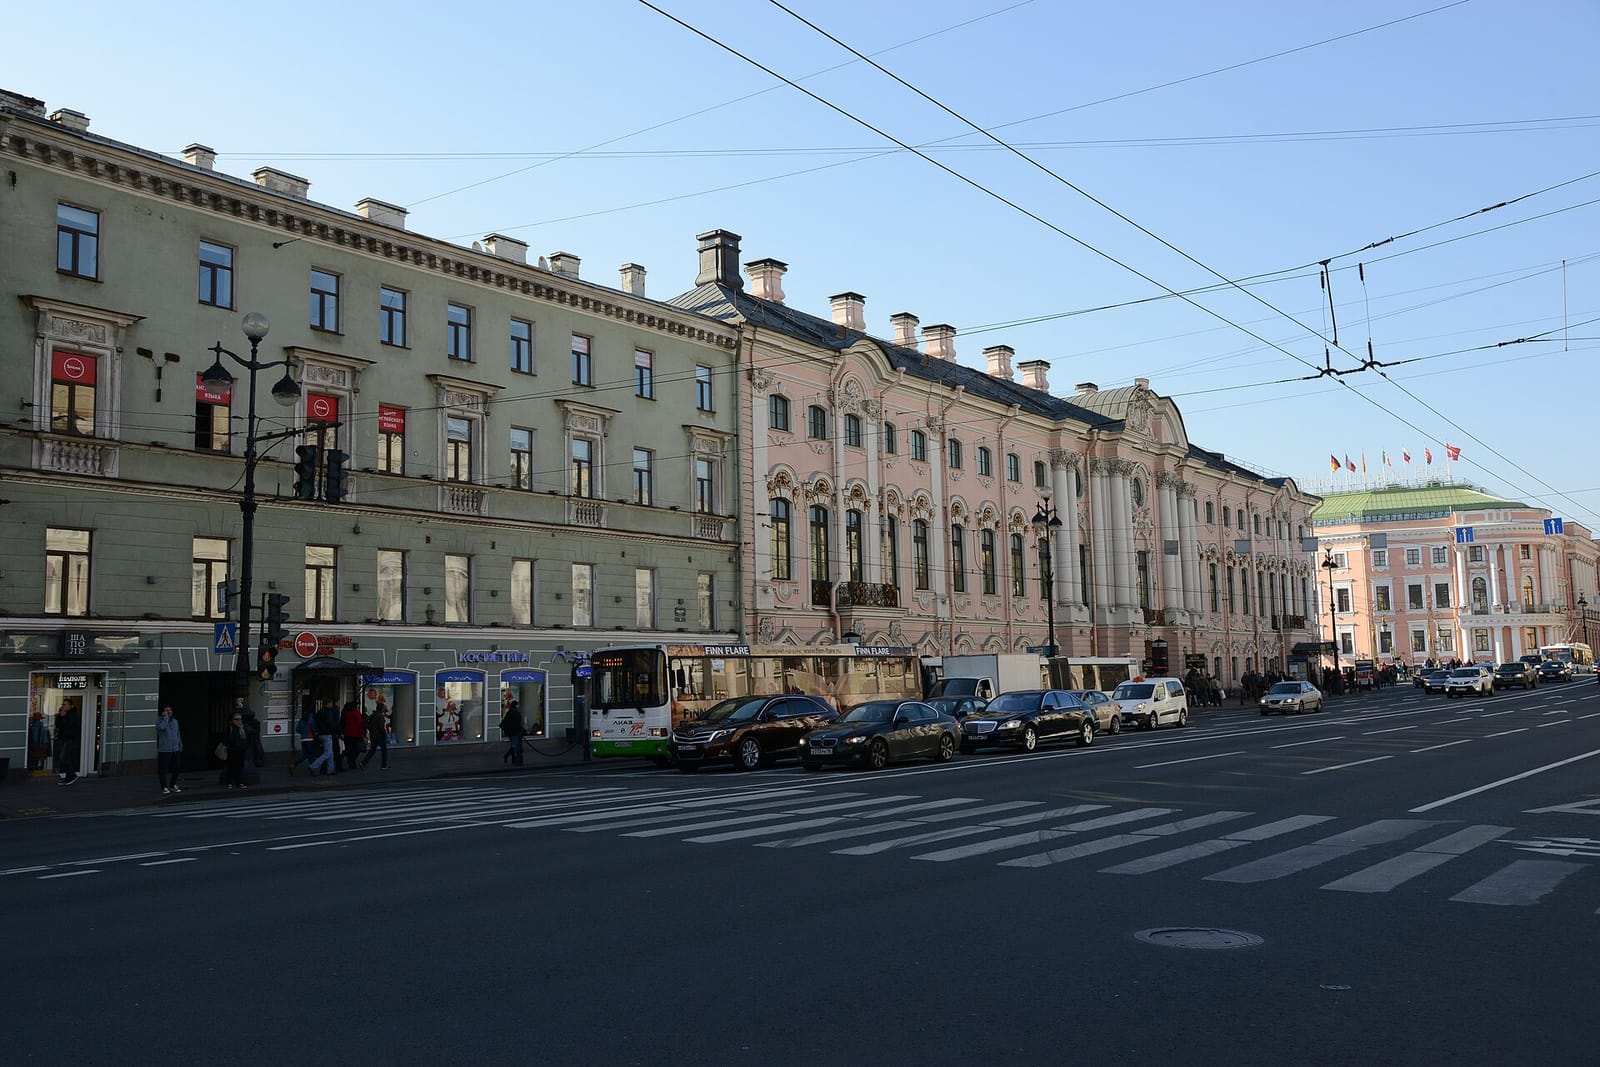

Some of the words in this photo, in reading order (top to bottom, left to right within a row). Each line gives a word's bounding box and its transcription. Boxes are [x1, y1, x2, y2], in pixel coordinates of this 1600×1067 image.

[70, 633, 86, 641] ША
[705, 646, 724, 655] FINN
[725, 646, 750, 655] FLARE
[856, 647, 870, 655] FINN
[871, 647, 890, 655] FLARE
[458, 651, 529, 663] КОСМЕТИКА
